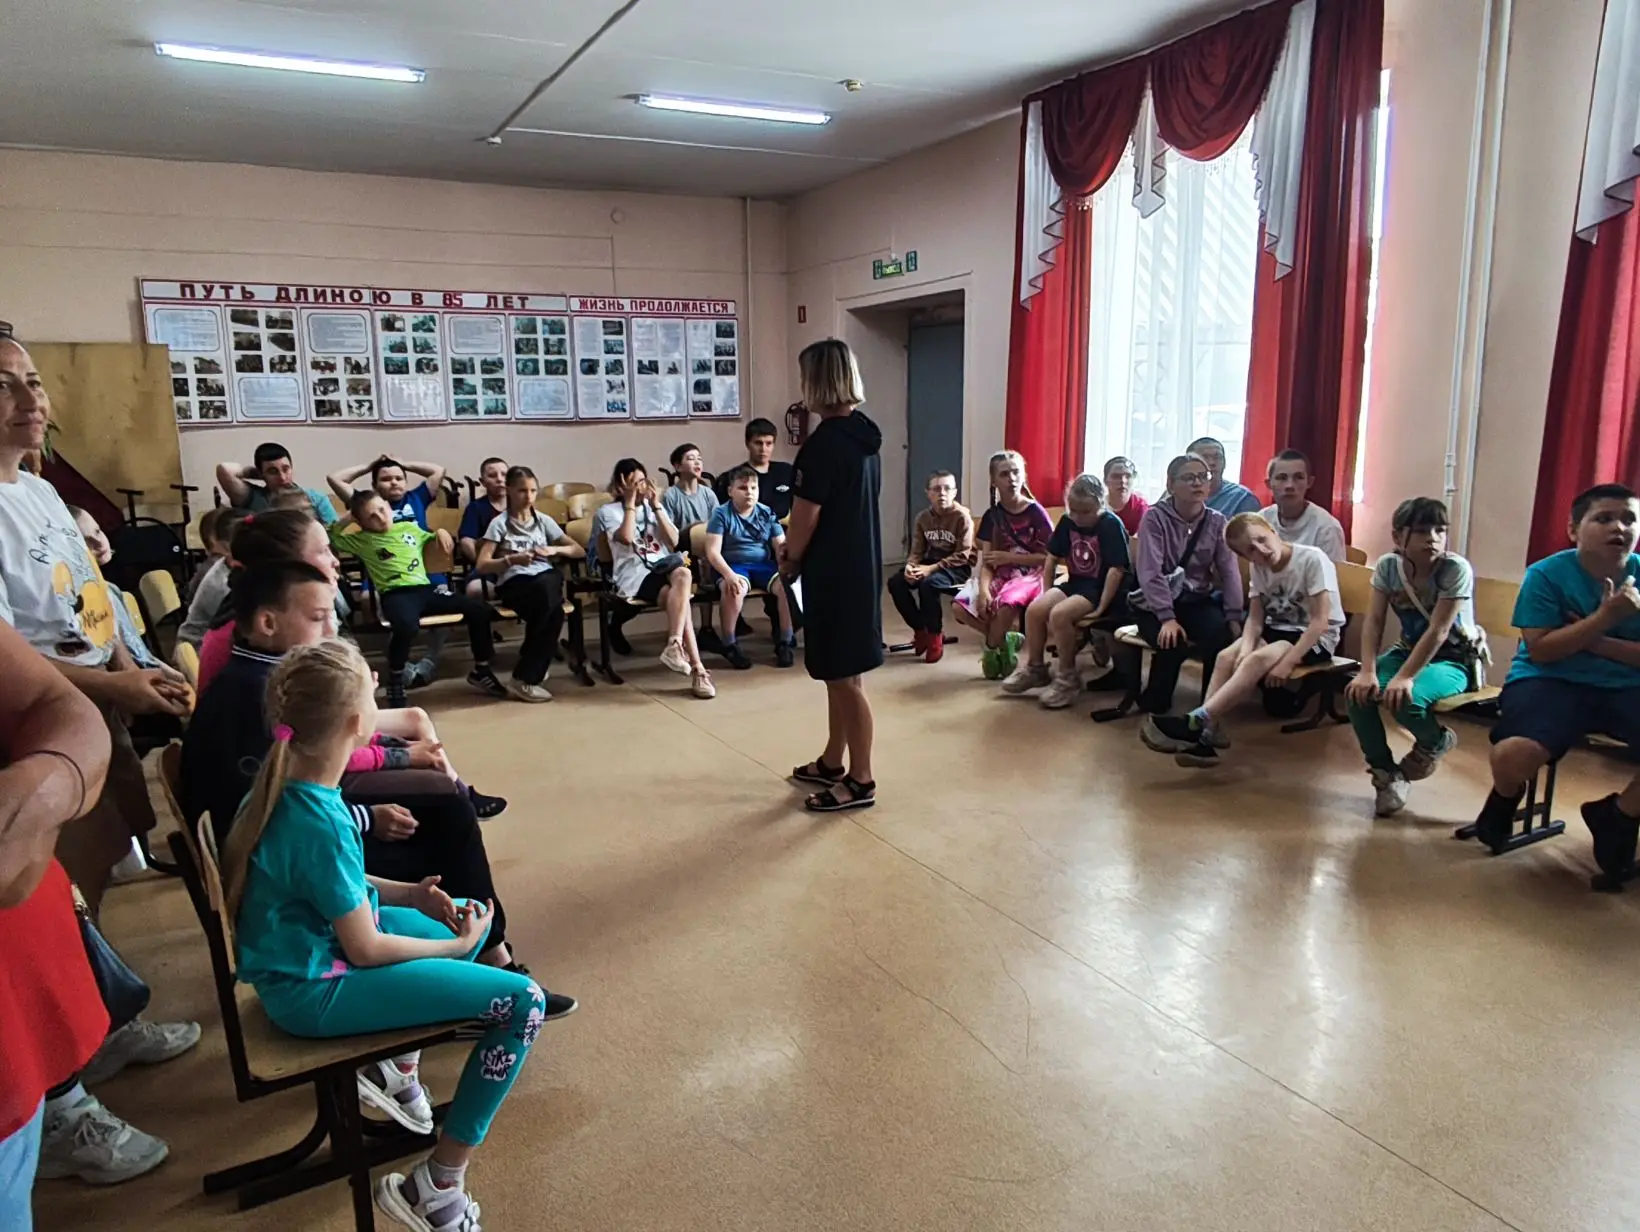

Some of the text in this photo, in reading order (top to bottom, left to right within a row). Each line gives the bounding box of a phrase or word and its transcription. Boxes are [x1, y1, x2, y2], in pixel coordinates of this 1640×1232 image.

[179, 283, 529, 309] ПУТЬ ДЛИНОЮ В 85 ЛЕТ
[578, 298, 729, 313] ЖИЗНЬ ПРОДОЛЖАЕТСЯ
